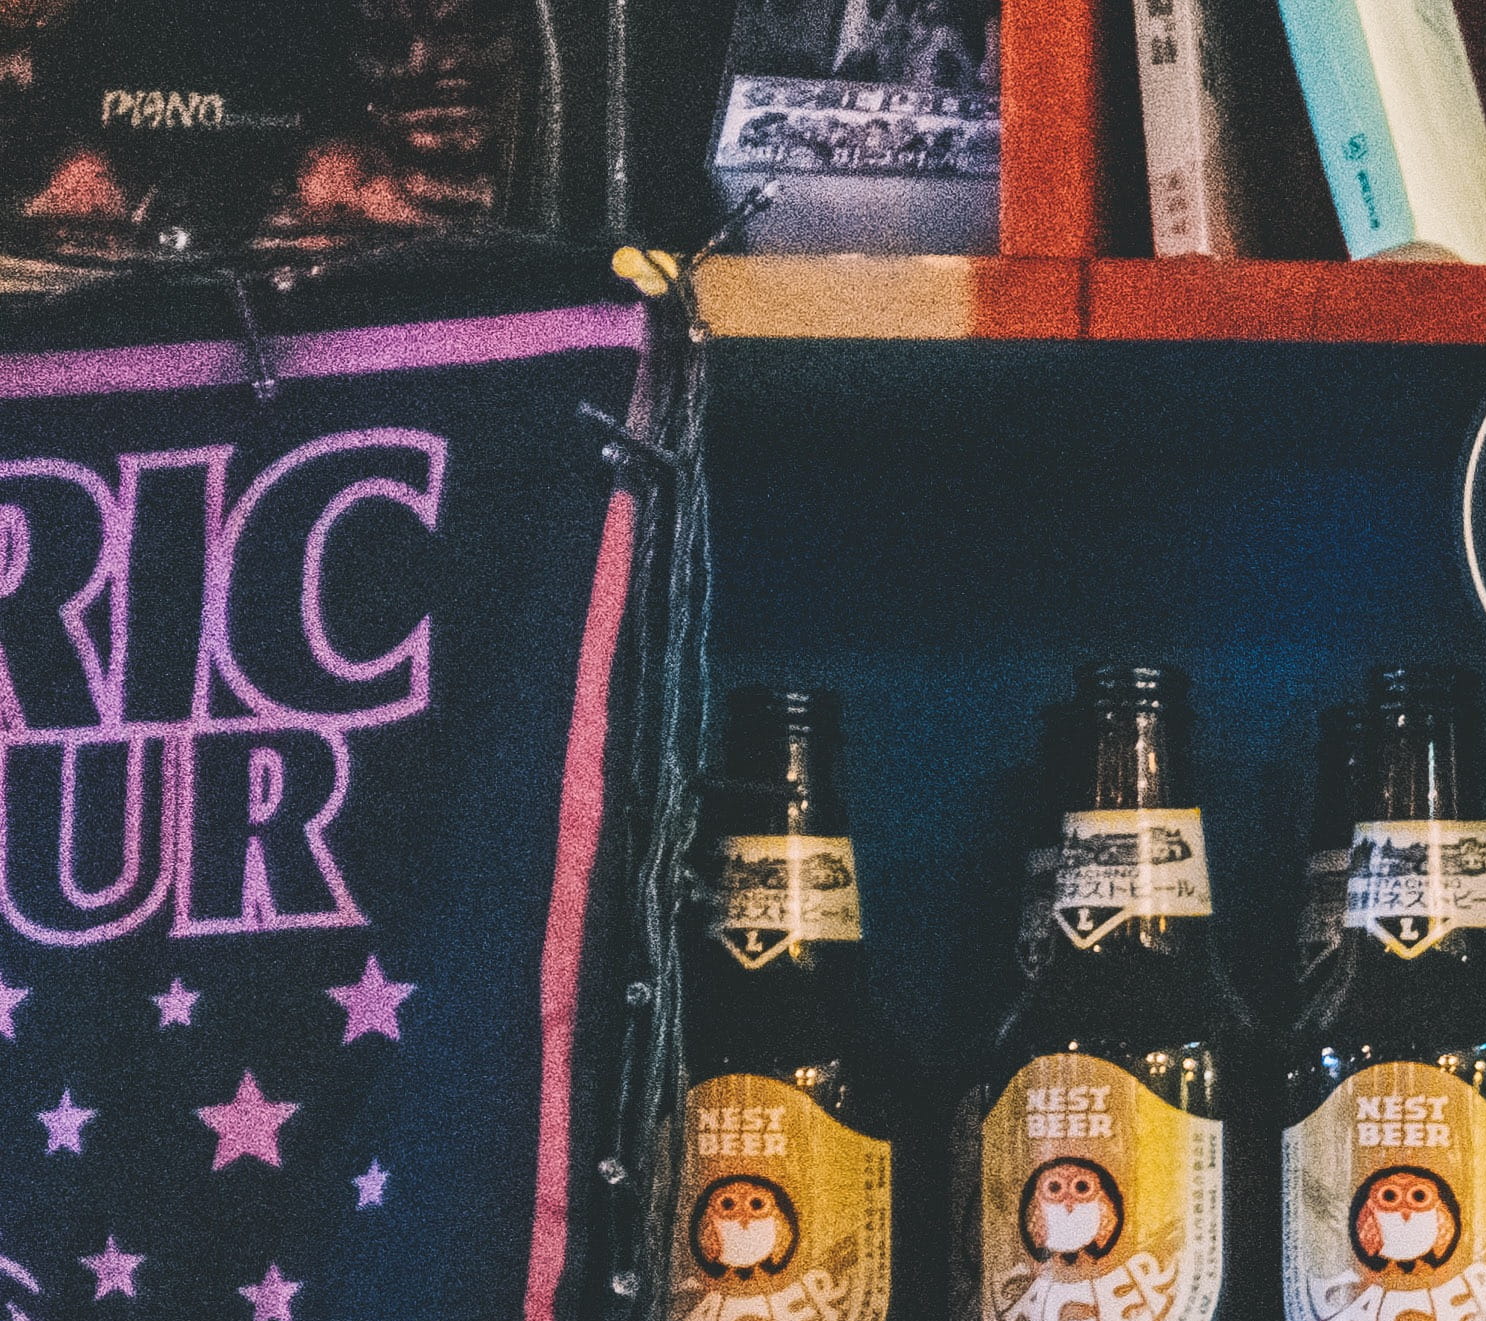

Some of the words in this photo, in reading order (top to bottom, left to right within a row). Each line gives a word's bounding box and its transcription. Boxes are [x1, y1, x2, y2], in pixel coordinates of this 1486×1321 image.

[1026, 1085, 1111, 1113] NEST
[1357, 1095, 1448, 1122] NEST
[699, 1105, 785, 1134] NEST
[1027, 1113, 1113, 1139] BEER
[699, 1134, 787, 1156] BEER
[1358, 1122, 1452, 1148] BEER
